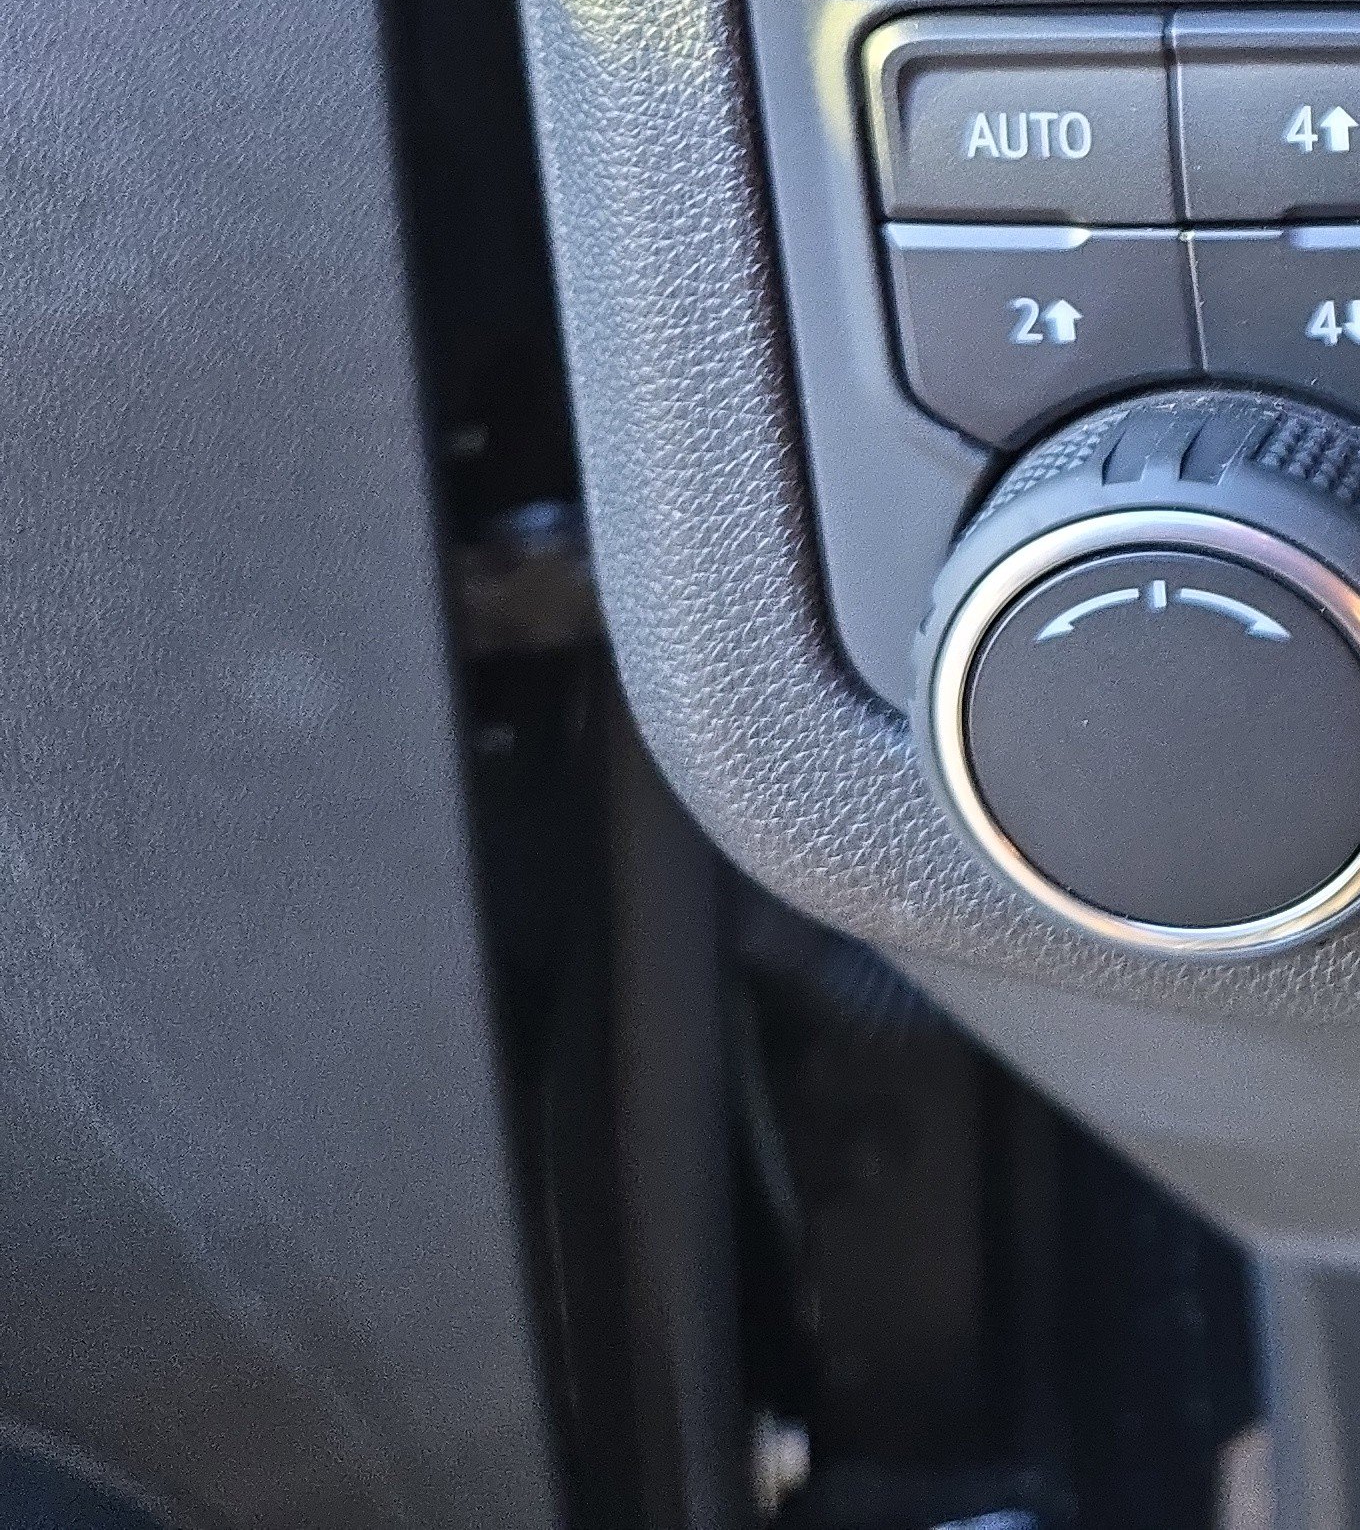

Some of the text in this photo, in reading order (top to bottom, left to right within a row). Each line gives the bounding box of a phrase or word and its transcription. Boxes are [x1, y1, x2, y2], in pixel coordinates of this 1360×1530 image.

[966, 111, 1093, 160] AUTO
[1285, 106, 1318, 152] 4
[1012, 298, 1044, 345] 2
[1306, 300, 1342, 346] 4
